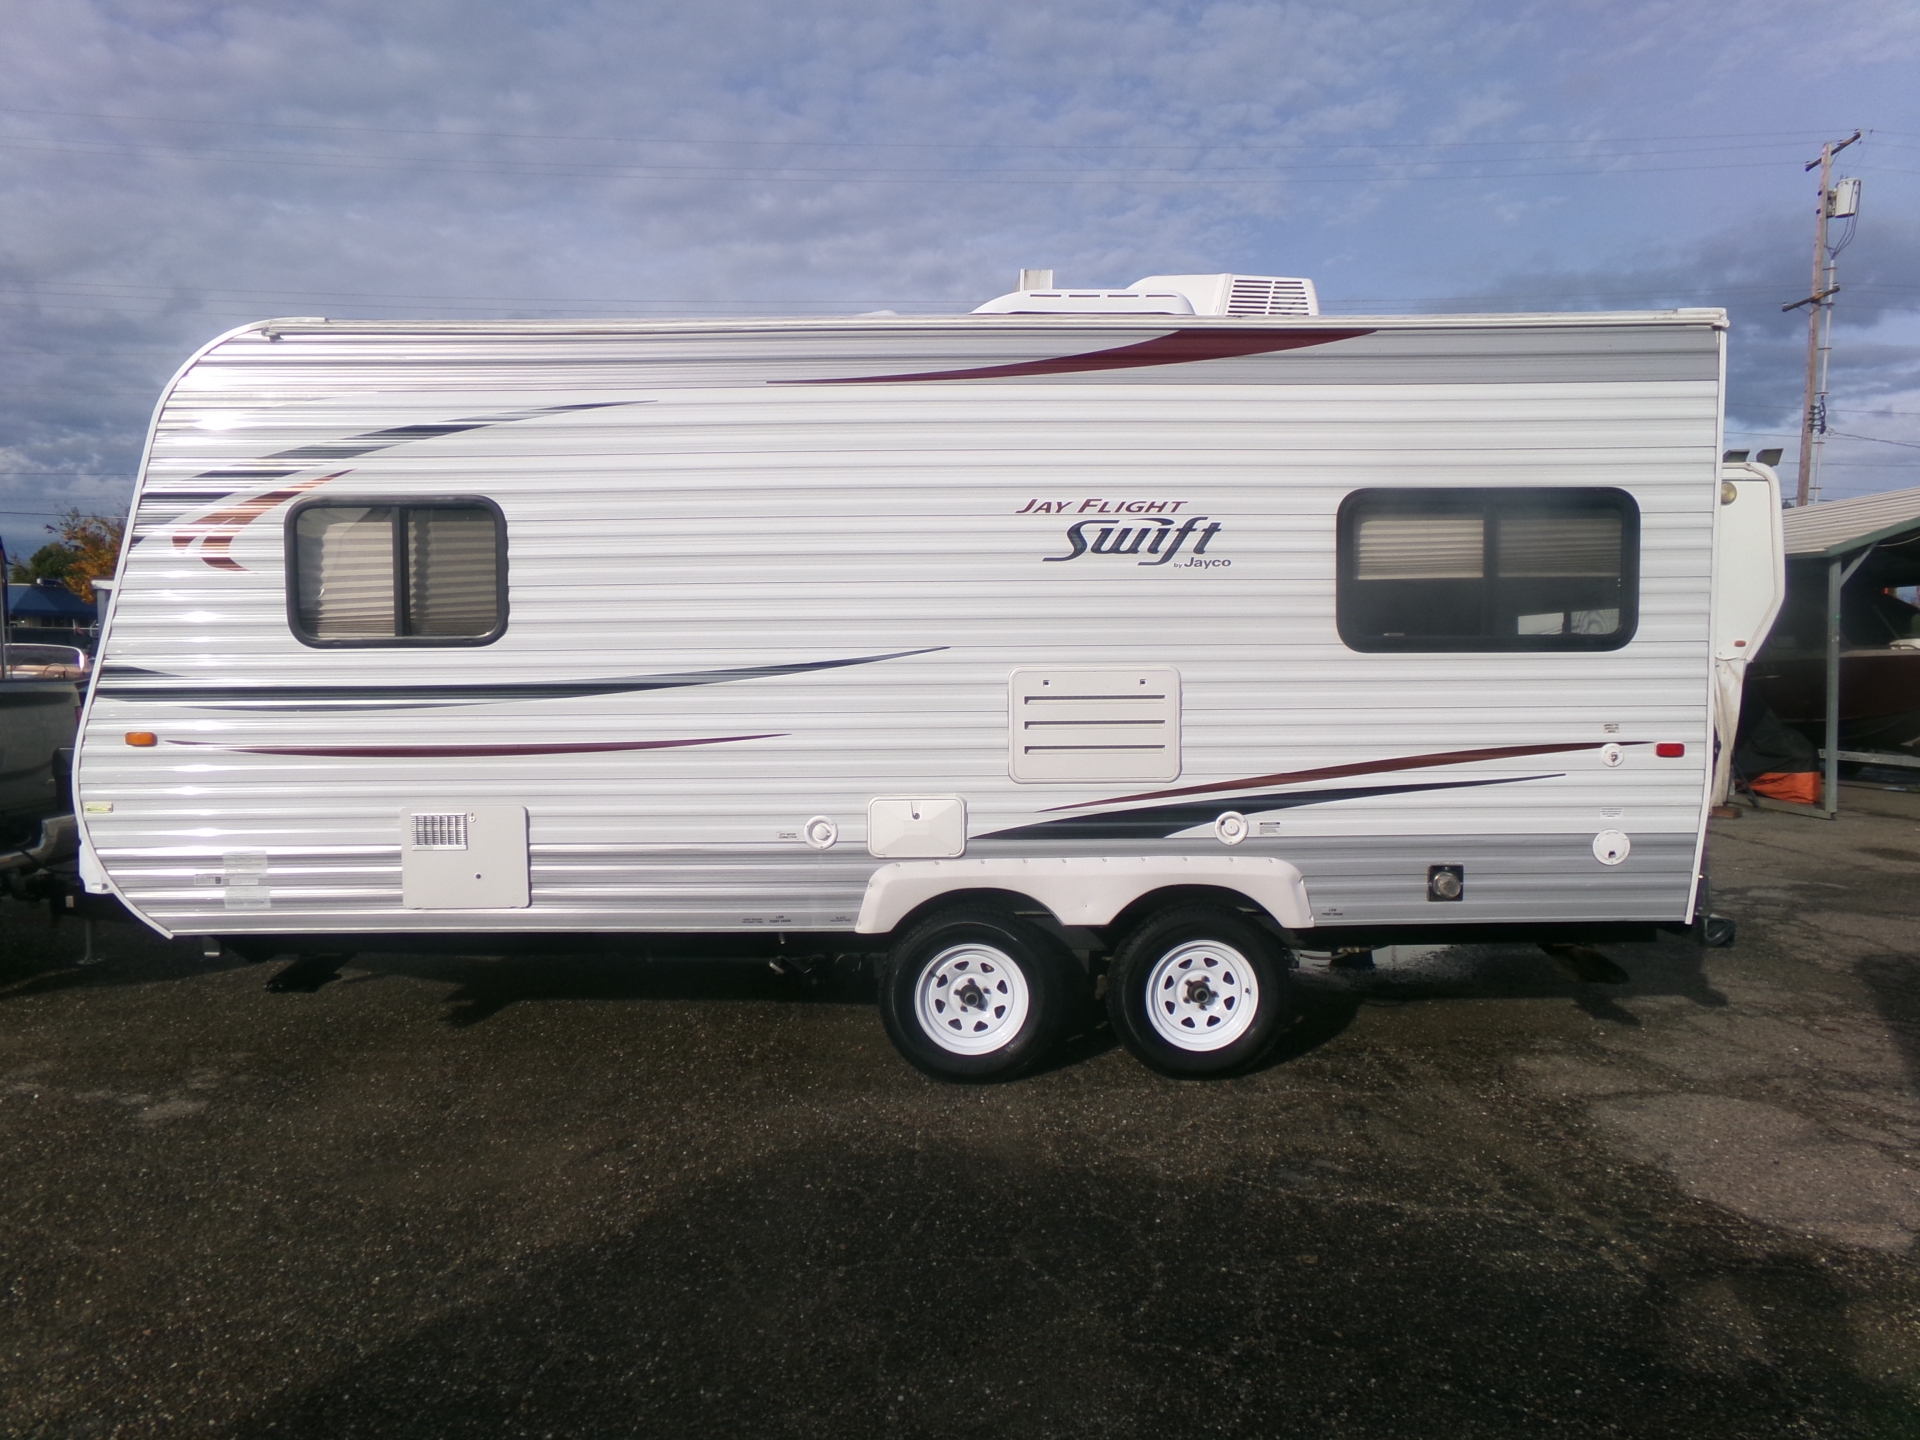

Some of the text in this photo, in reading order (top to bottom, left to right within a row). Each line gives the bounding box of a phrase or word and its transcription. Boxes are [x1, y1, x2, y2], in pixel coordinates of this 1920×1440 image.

[1015, 498, 1189, 514] JAY FLIGHT
[1042, 516, 1222, 566] Swift
[1184, 556, 1232, 570] Jayco
